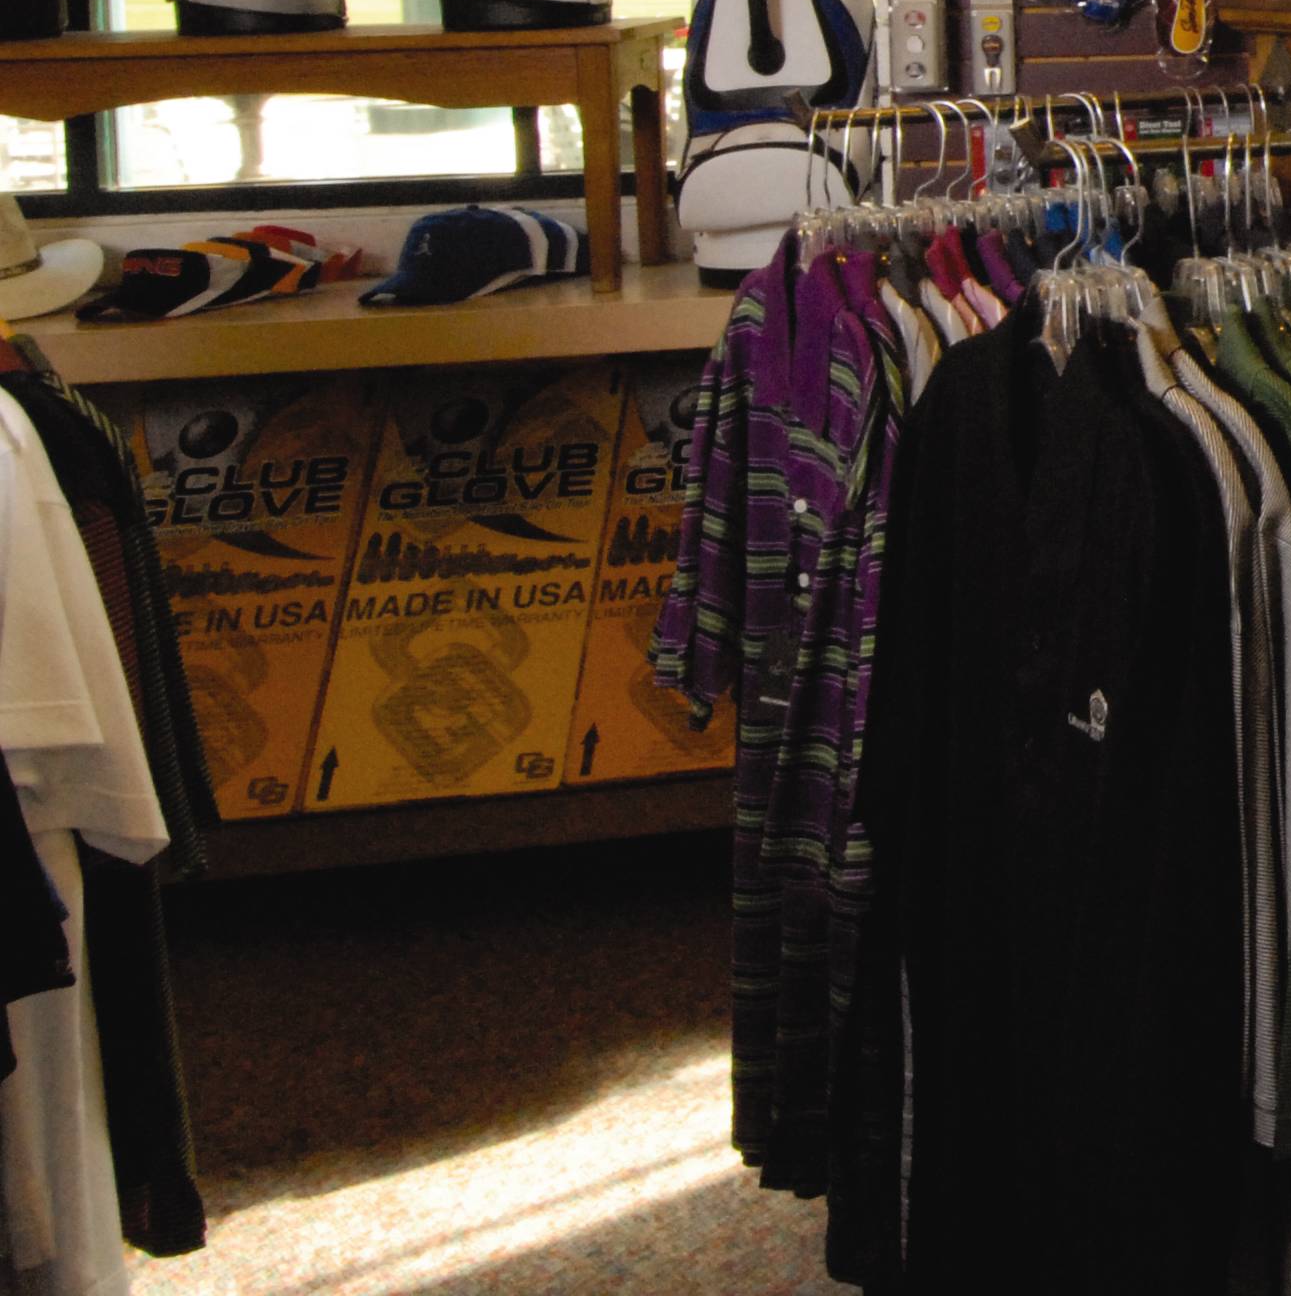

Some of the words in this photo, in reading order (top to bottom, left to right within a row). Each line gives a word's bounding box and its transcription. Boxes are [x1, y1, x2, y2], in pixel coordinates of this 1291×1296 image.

[174, 456, 350, 496] CLUB
[428, 442, 599, 479] CLUB
[378, 468, 596, 510] GLOVE
[206, 607, 243, 632] IN
[254, 599, 328, 629] USA
[345, 590, 455, 622] MADE
[465, 587, 500, 614] IN
[513, 580, 586, 609] USA
